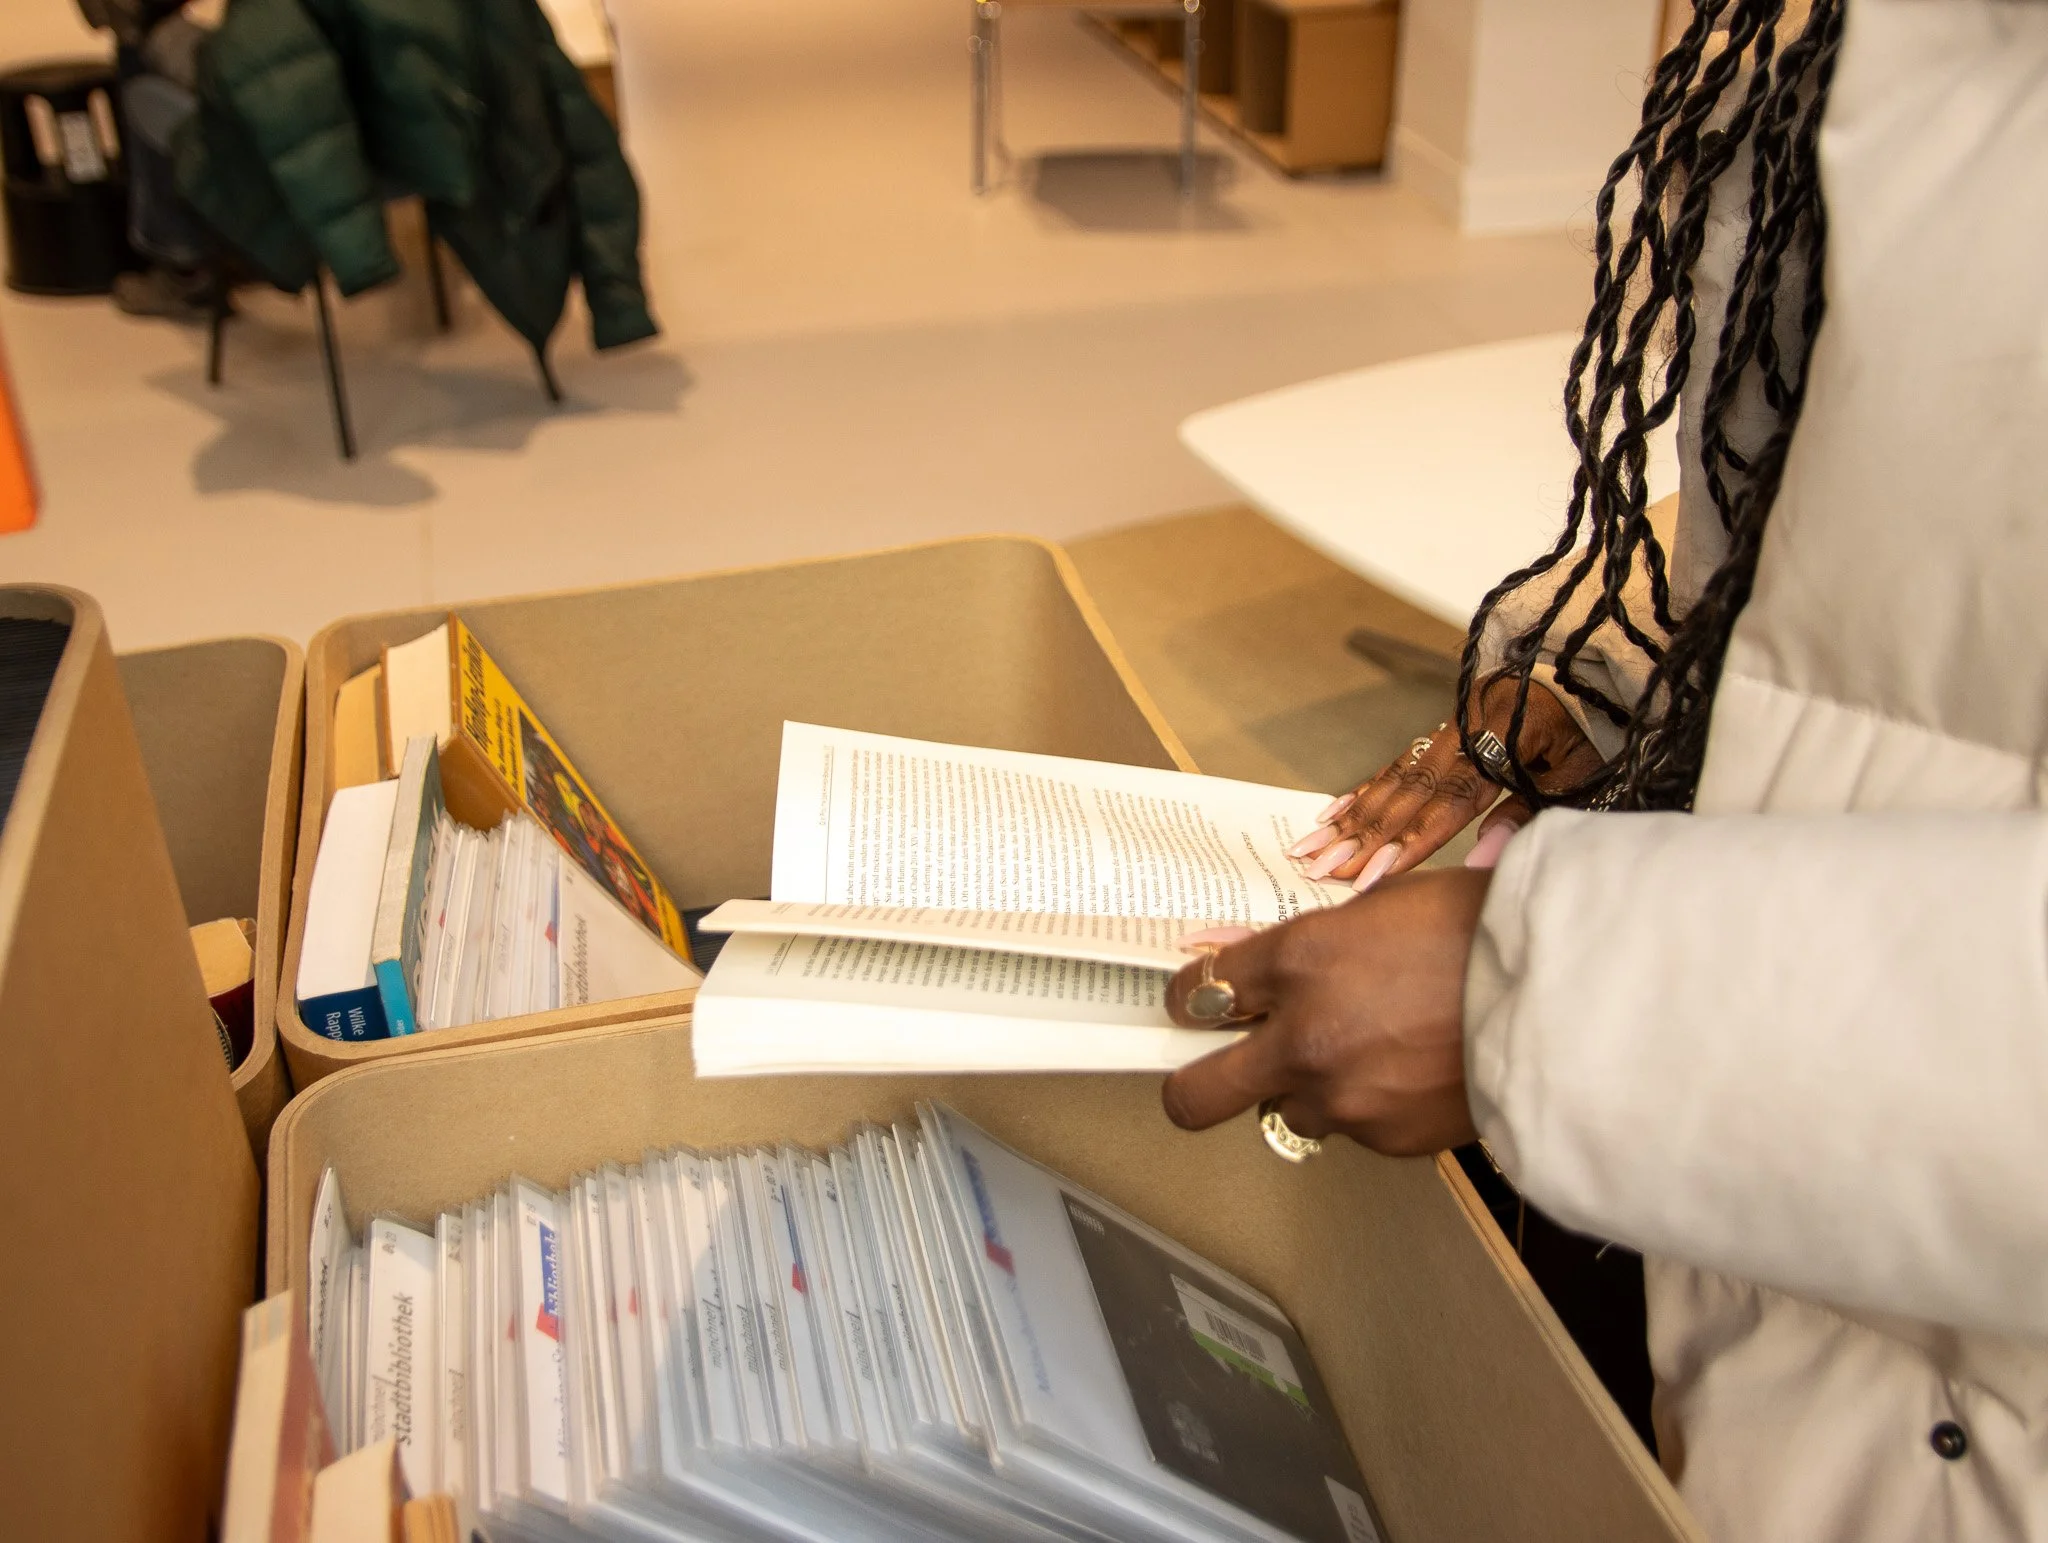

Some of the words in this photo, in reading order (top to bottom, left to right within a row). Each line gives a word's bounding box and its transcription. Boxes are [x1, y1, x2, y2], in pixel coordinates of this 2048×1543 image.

[923, 864, 932, 892] referring
[986, 866, 996, 900] politischen
[1050, 869, 1058, 882] Jean
[1050, 884, 1058, 896] und
[1088, 885, 1096, 900] lokal
[1114, 888, 1122, 916] weifellos
[1089, 902, 1097, 914] die
[1205, 902, 1213, 920] Dann
[348, 1006, 366, 1036] Wilke
[704, 1305, 722, 1369] münchner
[738, 1310, 760, 1374] münchner
[849, 1318, 872, 1382] münchner
[388, 1293, 414, 1446] stadtbibliothek
